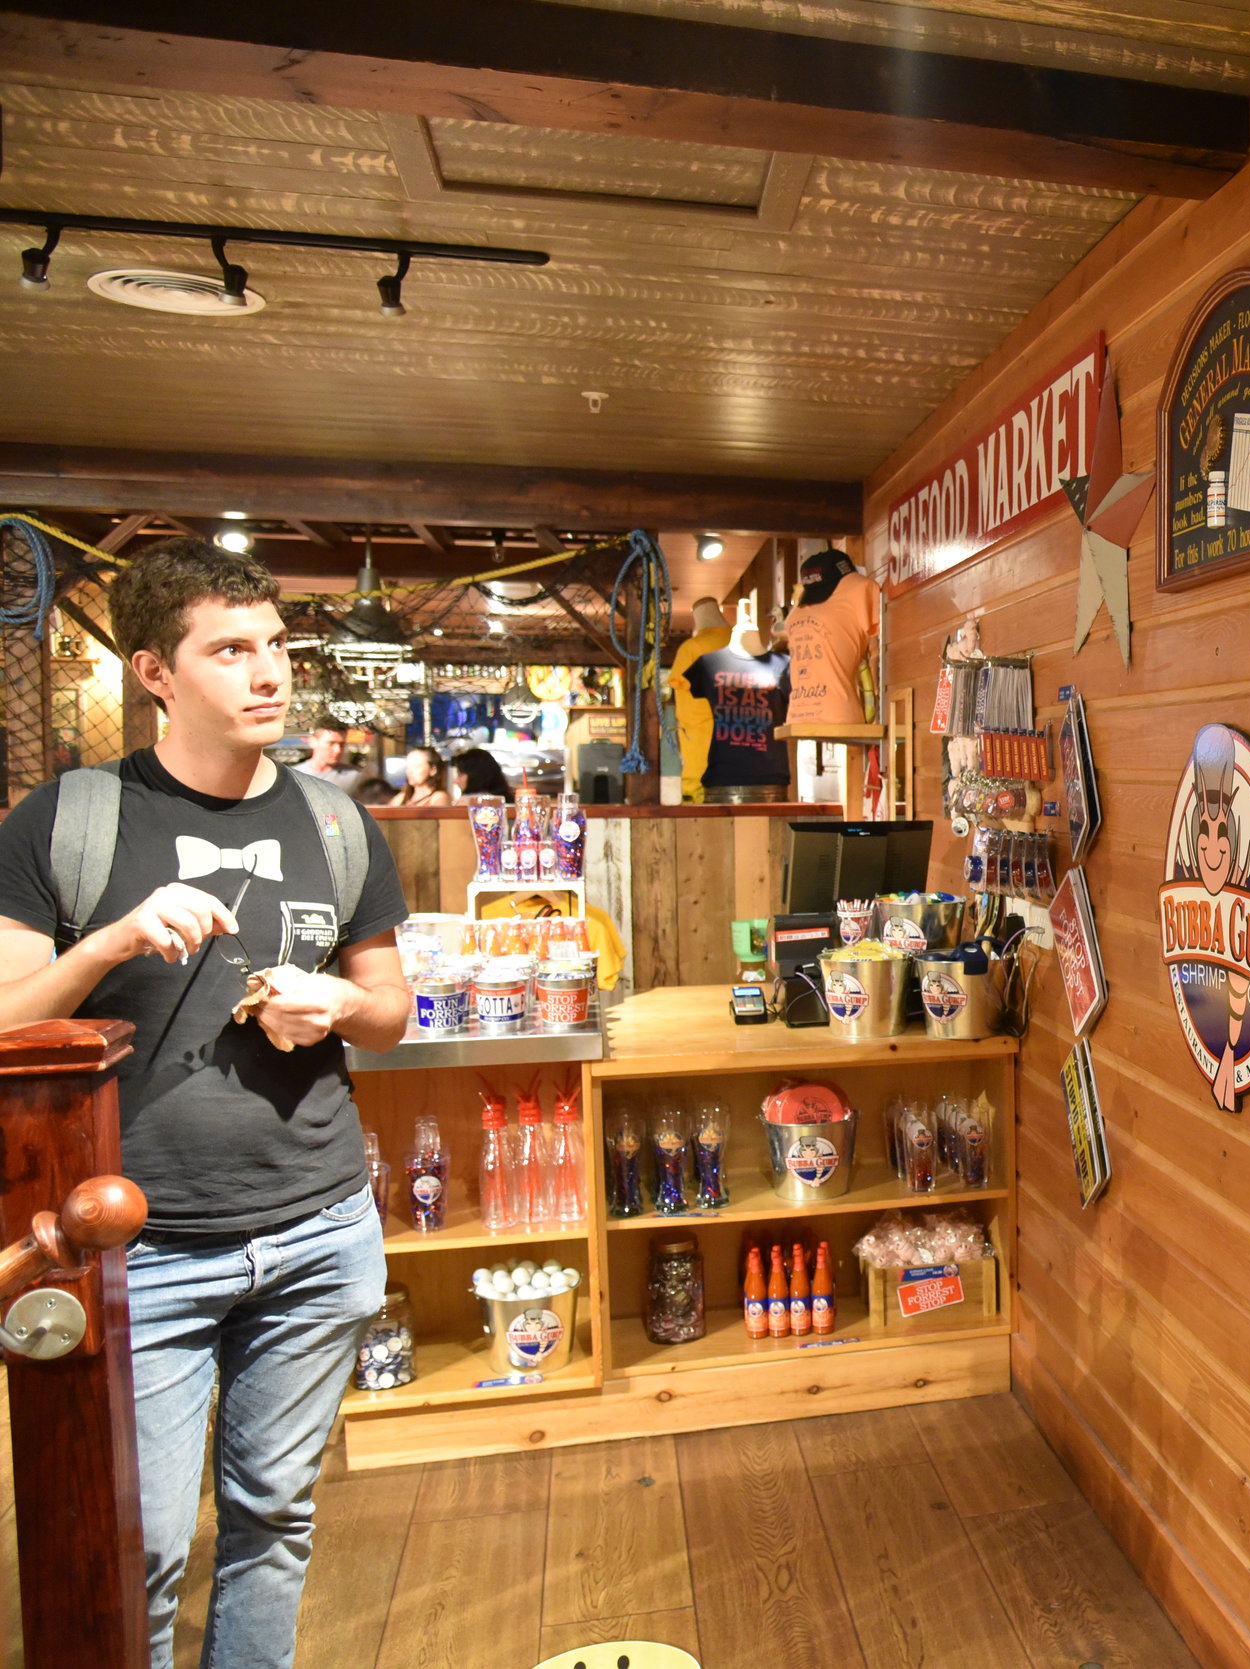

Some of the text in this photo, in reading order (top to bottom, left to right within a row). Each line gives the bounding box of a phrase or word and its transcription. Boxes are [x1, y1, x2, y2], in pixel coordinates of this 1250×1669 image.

[1209, 320, 1231, 354] MAKER
[1179, 353, 1230, 451] GENERAL
[888, 352, 1095, 586] SEAFOOD MARKET
[1187, 472, 1198, 488] the
[1174, 491, 1203, 512] numbers
[1172, 506, 1206, 532] look bad.
[1174, 549, 1184, 570] For
[1187, 543, 1198, 565] this
[1206, 534, 1224, 558] work
[1227, 528, 1237, 552] 70
[717, 687, 769, 708] IS AS
[713, 705, 774, 726] STUPID
[716, 722, 768, 743] DOES
[1163, 895, 1226, 955] BUBBA
[1060, 909, 1085, 996] FORREST
[1069, 918, 1086, 968] STOP
[1181, 963, 1227, 990] SHRIMP
[433, 1000, 459, 1010] RUN
[547, 994, 577, 1004] STOP
[845, 994, 868, 1005] GUMP
[941, 994, 966, 1005] GUMP
[420, 1007, 464, 1019] FORRE
[434, 1017, 459, 1028] RUN
[547, 1012, 577, 1022] STOP
[1171, 967, 1215, 1075] RESTAURANT
[1235, 1070, 1243, 1083] &
[907, 1285, 955, 1306] FORREST
[915, 1280, 944, 1296] STOP
[919, 1296, 947, 1311] STOP
[508, 1333, 538, 1342] BUBBA
